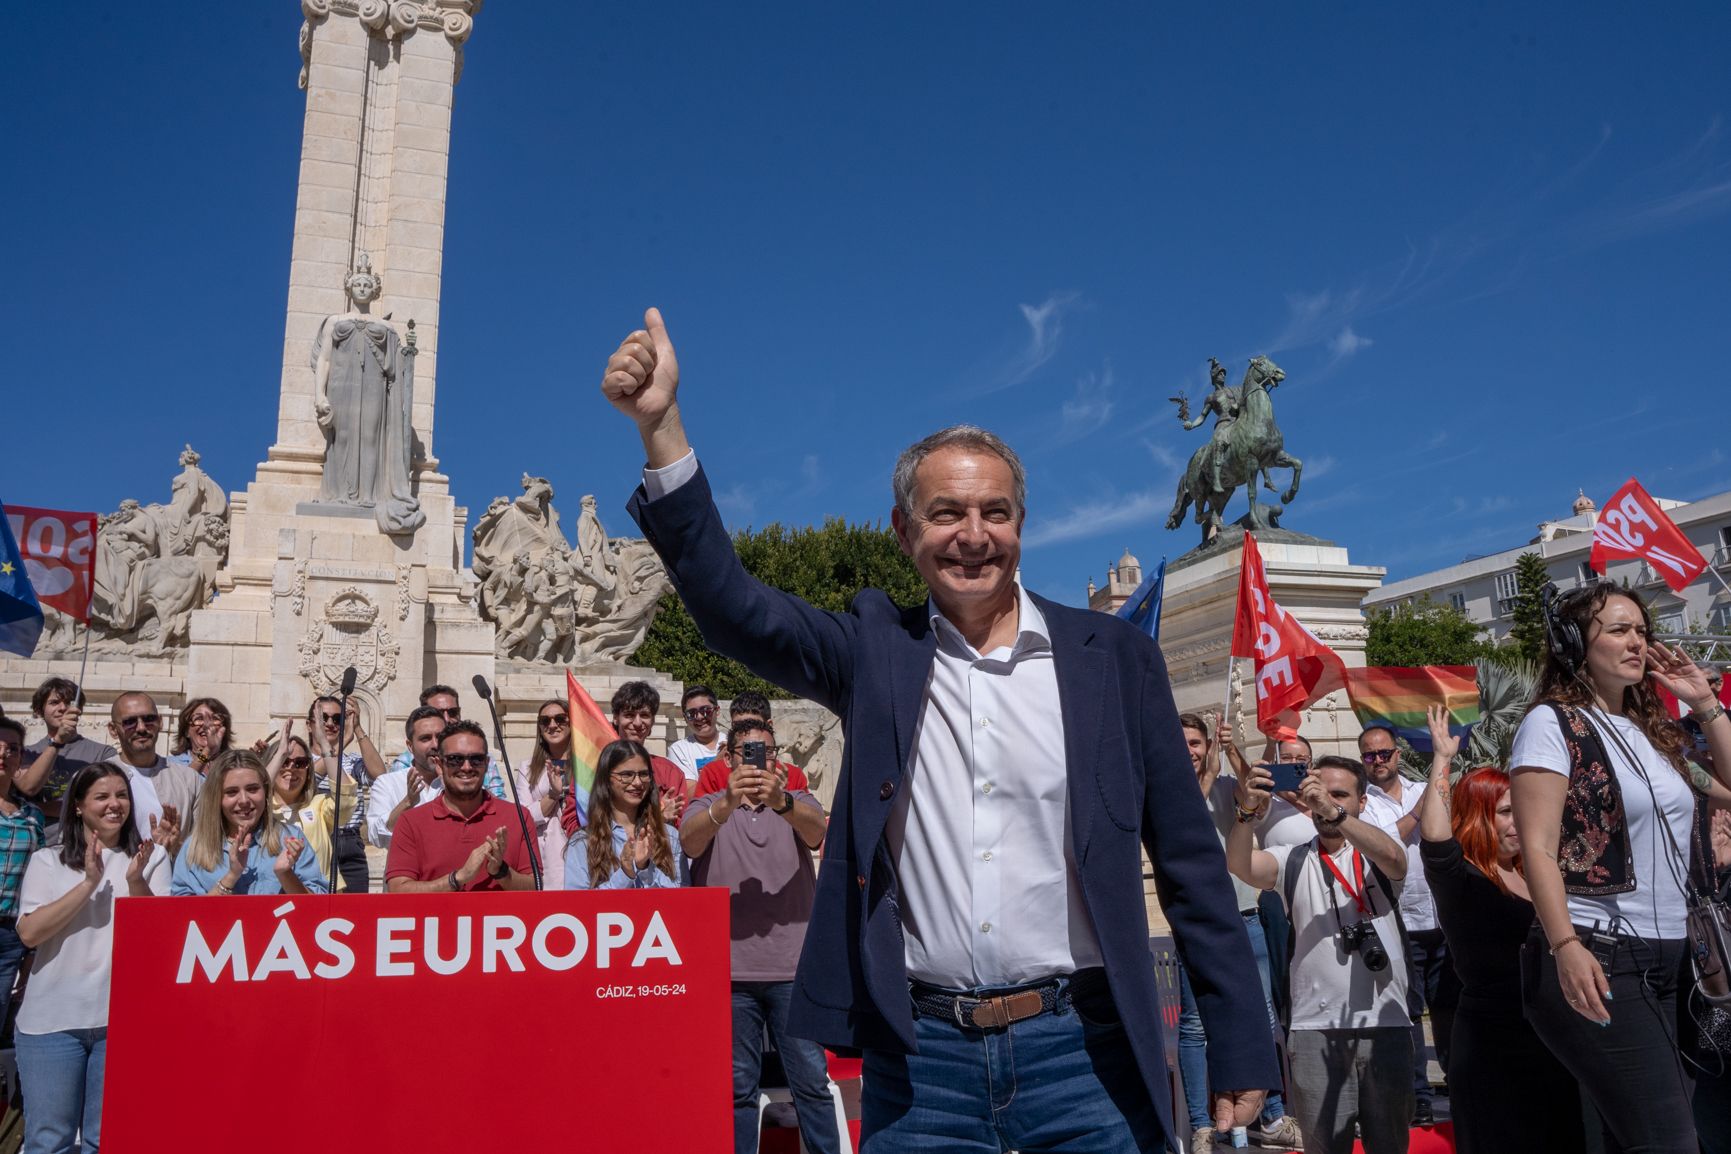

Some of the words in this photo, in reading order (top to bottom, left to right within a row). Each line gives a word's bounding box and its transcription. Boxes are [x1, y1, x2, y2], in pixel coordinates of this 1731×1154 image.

[175, 900, 356, 984] MÁS
[375, 910, 683, 977] EUROPA
[596, 984, 636, 998] CÁDIZ,
[637, 983, 687, 997] 19-05-24
